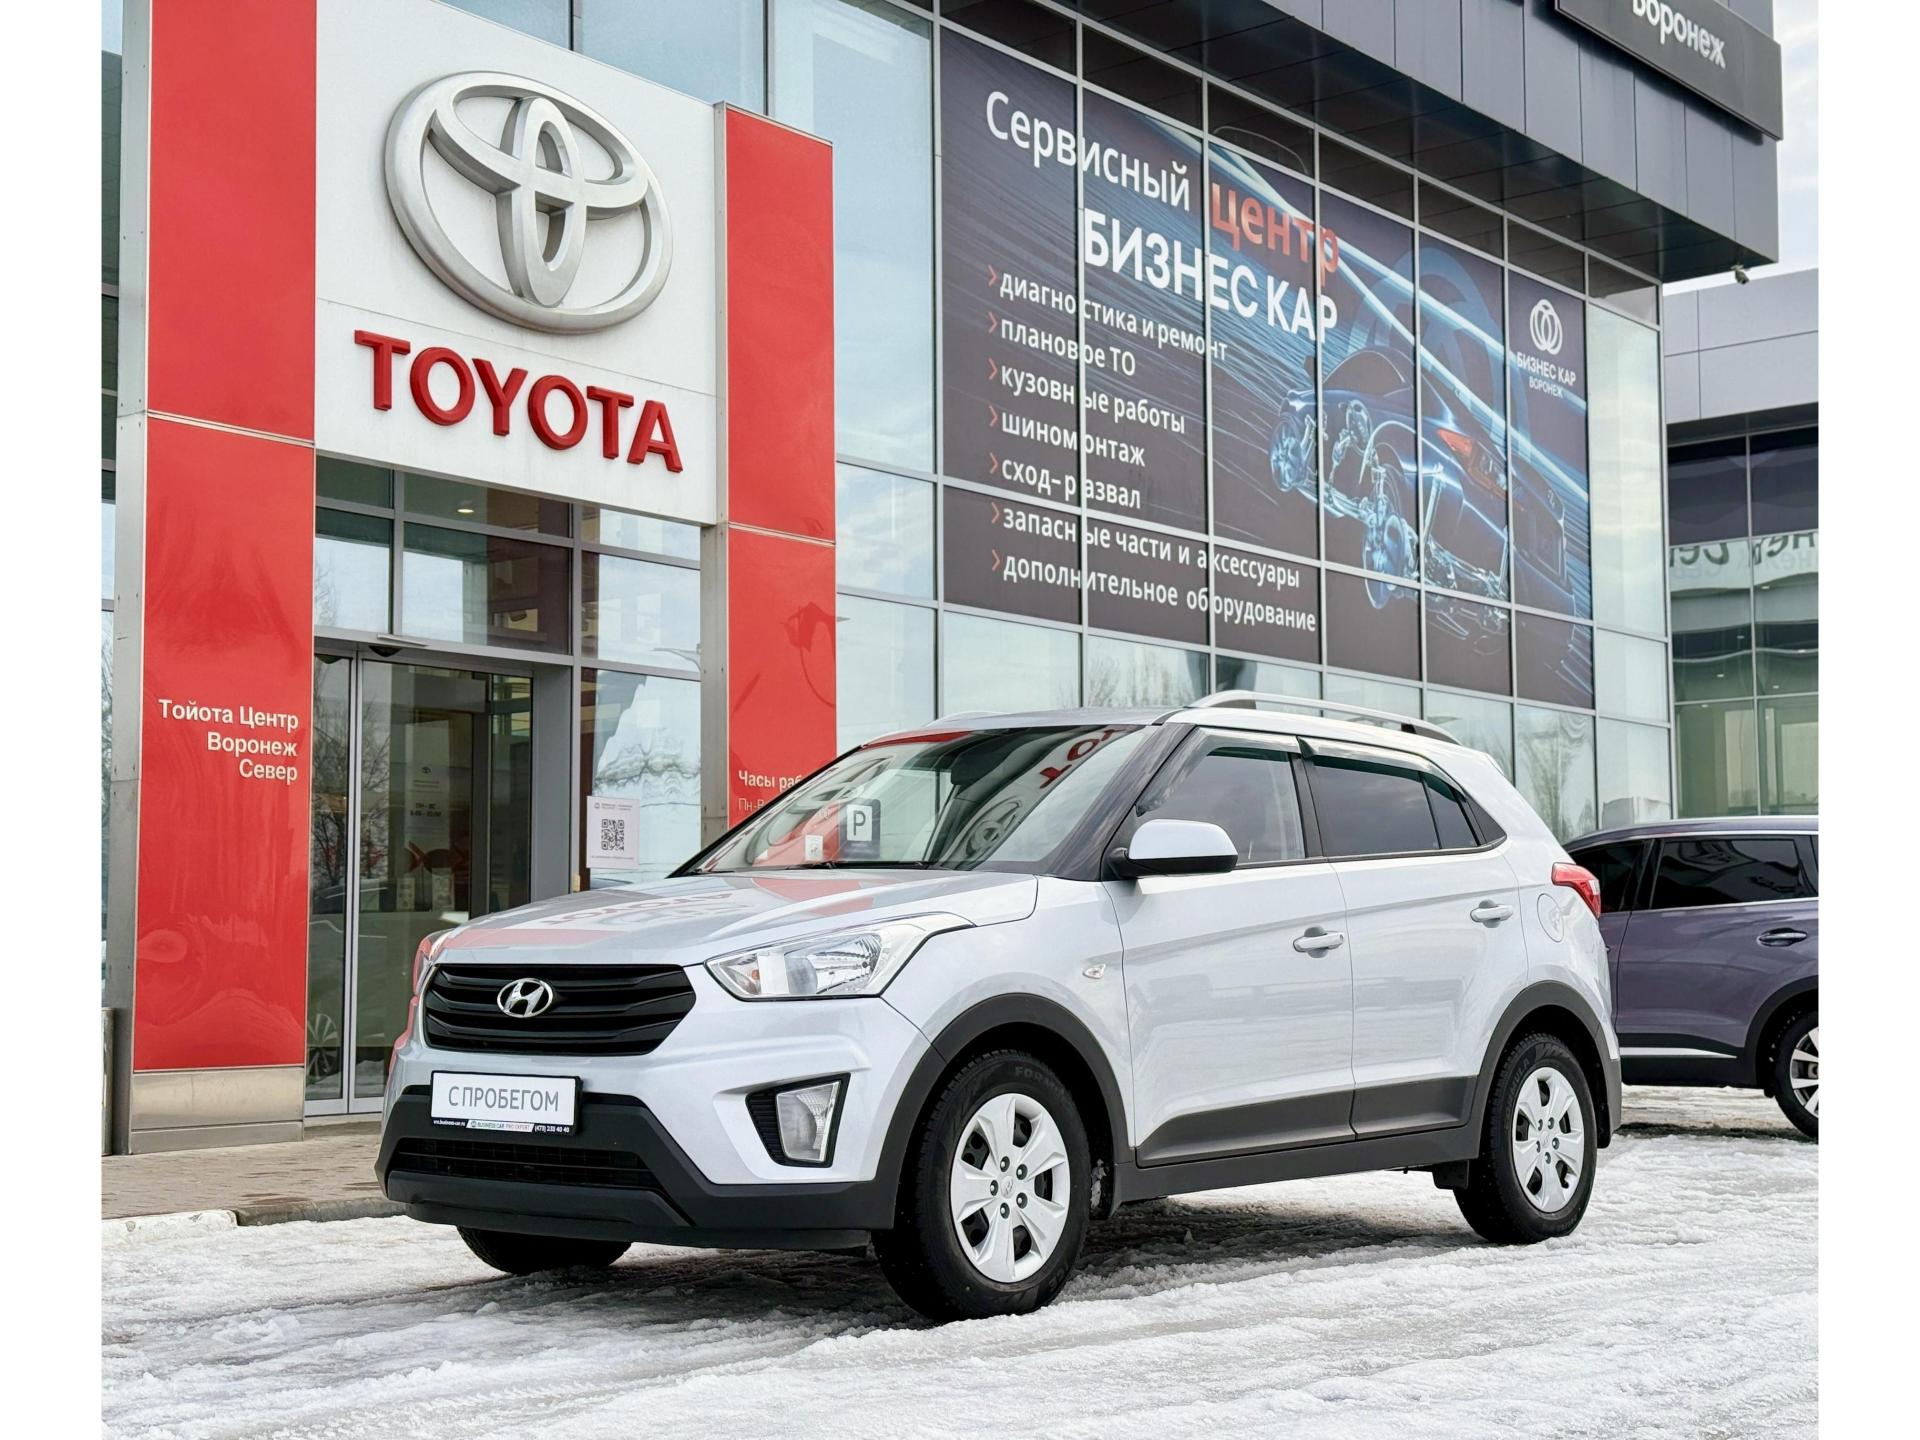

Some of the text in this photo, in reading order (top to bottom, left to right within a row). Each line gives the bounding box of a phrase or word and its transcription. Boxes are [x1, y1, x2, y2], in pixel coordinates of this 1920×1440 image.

[986, 91, 1340, 288] Сервисный центр
[1084, 208, 1338, 344] БИЗНЕС КАР
[1000, 272, 1228, 361] диагностика и ремонт
[1001, 319, 1136, 376] плановое ТО
[1516, 352, 1576, 386] БИЗНЕС КАР
[354, 330, 683, 472] TOYOTA
[1002, 365, 1185, 434] кузовные работы
[1529, 376, 1563, 399] ВОРОНЕЖ
[1002, 412, 1146, 467] шиномонтаж
[1003, 508, 1299, 591] запасные части и аксессуары
[1003, 556, 1316, 632] дополнительное оборудование
[158, 698, 299, 733] Тойота Центр
[207, 731, 297, 757] Воронеж
[239, 758, 298, 785] Север
[738, 770, 803, 793] Часы раб
[738, 798, 765, 812] Пн-В
